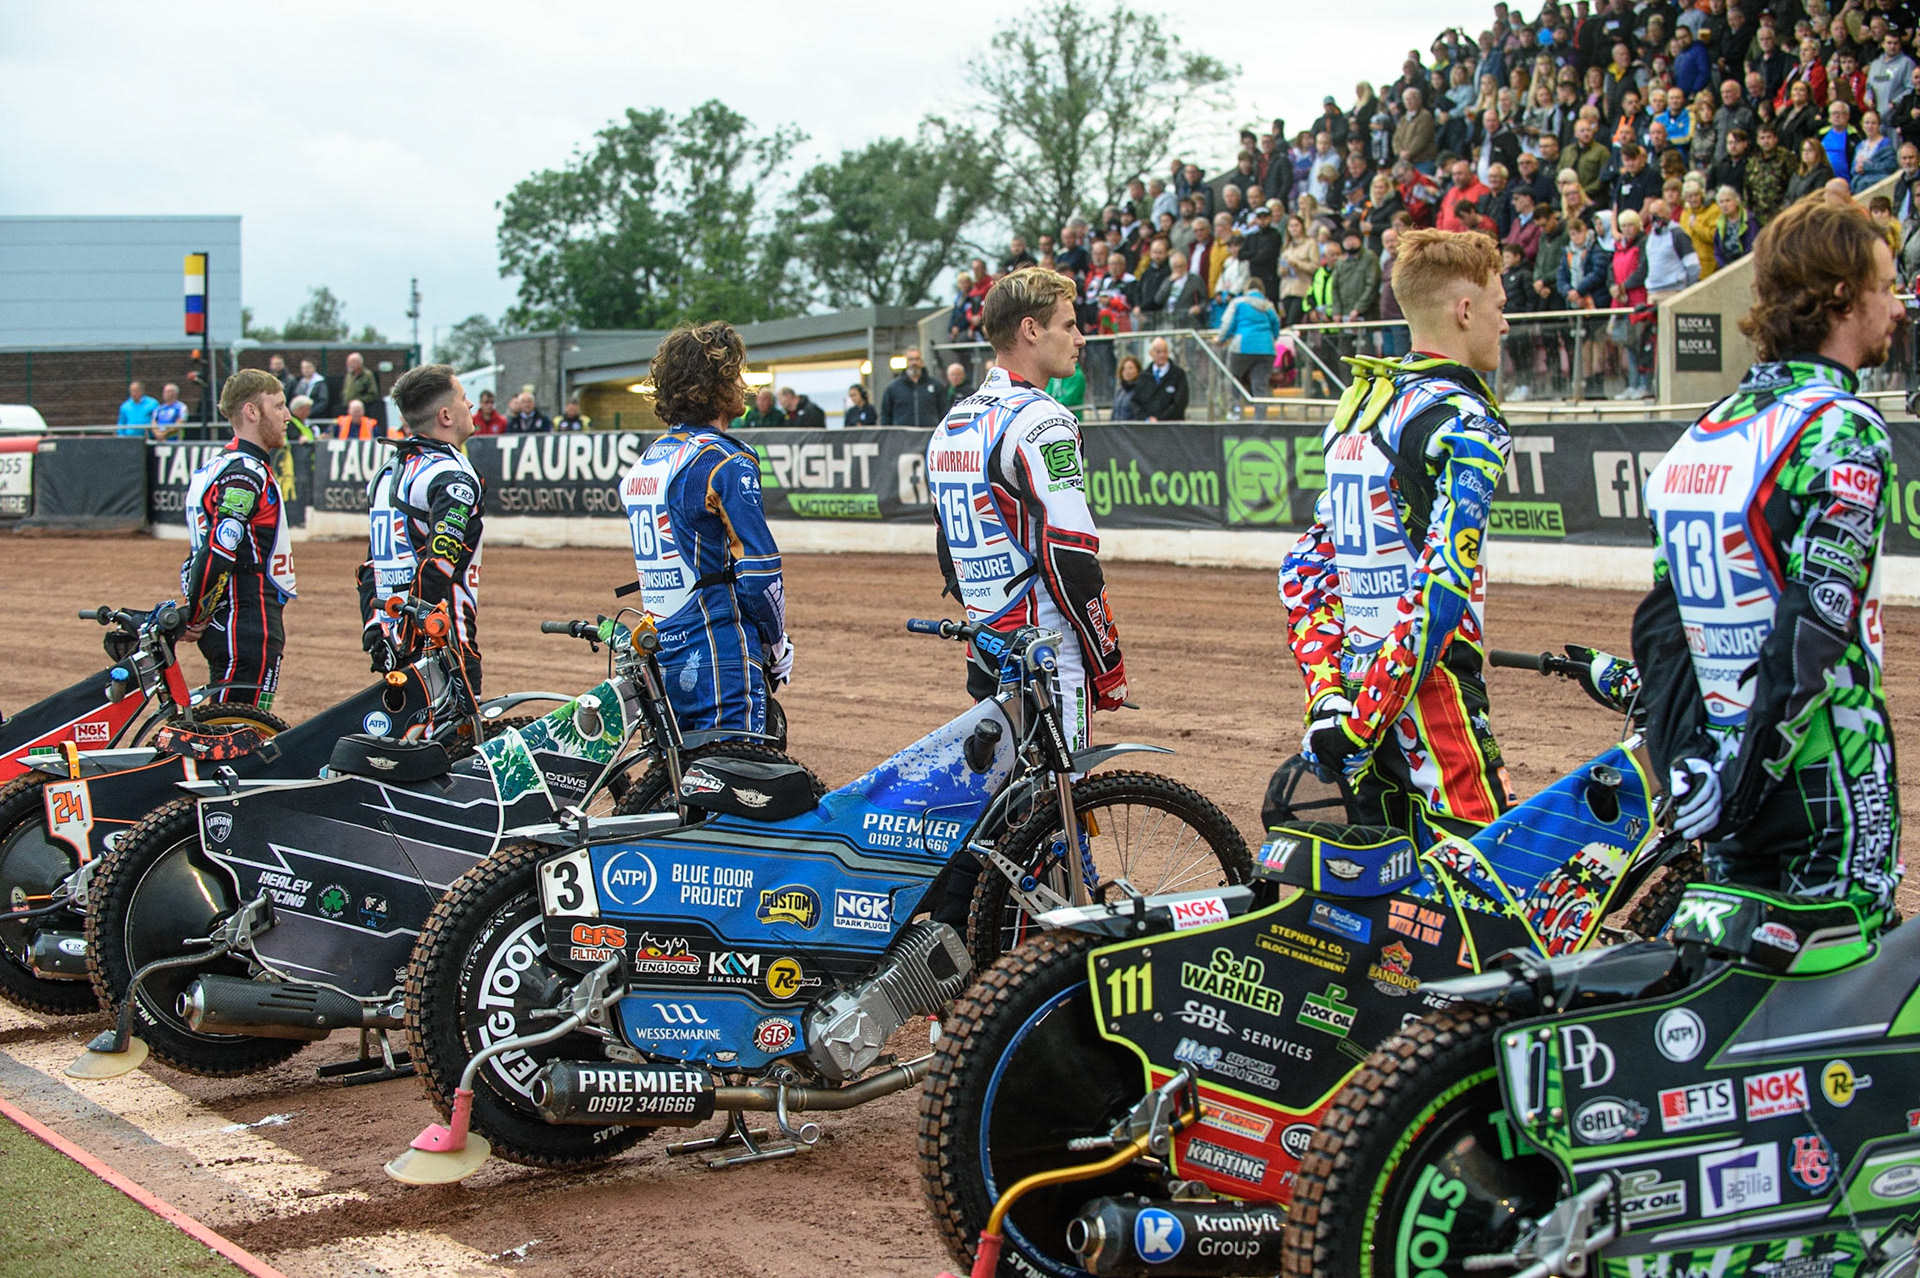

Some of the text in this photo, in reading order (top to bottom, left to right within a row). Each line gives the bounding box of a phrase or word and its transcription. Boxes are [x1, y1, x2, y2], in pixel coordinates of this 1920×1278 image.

[1678, 317, 1712, 328] BLOCK A
[1678, 339, 1703, 349] BLOCK
[496, 433, 640, 482] TAURUS
[1335, 435, 1367, 461] ROWE
[929, 450, 981, 472] S. WORRALL
[626, 477, 659, 496] LAWSON
[1664, 463, 1733, 495] WRIGHT
[1831, 467, 1879, 496] NGK
[499, 487, 576, 511] SECURITY
[799, 499, 876, 515] MOTORBIKE
[941, 489, 970, 543] 15
[1333, 482, 1362, 547] 14
[372, 515, 388, 556] 17
[630, 510, 655, 556] 16
[1668, 519, 1718, 601] 13
[976, 631, 1005, 656] 56
[78, 723, 108, 737] NGK
[368, 719, 387, 729] ATPI
[560, 783, 587, 793] COATING
[52, 790, 84, 824] 24
[206, 816, 231, 828] LAWSON
[862, 813, 962, 840] PREMIER
[868, 832, 949, 853] 01912 341666
[611, 869, 648, 887] ATPI
[672, 863, 754, 889] BLUE DOOR
[1380, 848, 1413, 884] #111
[258, 871, 313, 894] HEALEY
[553, 861, 584, 911] 3
[681, 885, 744, 908] PROJECT
[762, 892, 812, 911] CUSTOM
[838, 894, 890, 921] NGK
[1175, 900, 1222, 920] NGK
[1315, 904, 1363, 932] GK Roofing
[1416, 908, 1446, 929] MAN
[836, 918, 888, 931] SPARK PLUGS
[1178, 919, 1202, 930] SPARK
[1270, 924, 1345, 956] STEPHEN & CO.
[1211, 948, 1265, 984] S&D
[1261, 940, 1347, 974] BLOCK MANAGEMENT
[725, 976, 758, 985] GLOBAL
[1106, 962, 1154, 1018] 111
[1183, 963, 1284, 1015] WARNER
[1367, 964, 1421, 992] BANDIDO
[1301, 1004, 1351, 1028] ROCK OIL
[635, 1027, 721, 1041] WESSEXMARINE
[763, 1026, 786, 1043] STS
[1181, 1000, 1314, 1062] SBL SERVICES
[1666, 1027, 1694, 1044] ATPI
[578, 1070, 703, 1093] PREMIER
[1745, 1071, 1804, 1107] NGK
[587, 1096, 696, 1113] 01912 341666
[1685, 1082, 1730, 1114] FTS
[1187, 1143, 1266, 1179] KARTING
[1727, 1174, 1773, 1202] agilia
[1649, 1194, 1680, 1208] OIL
[1195, 1213, 1281, 1236] Kranlyft
[1197, 1237, 1261, 1260] Group
